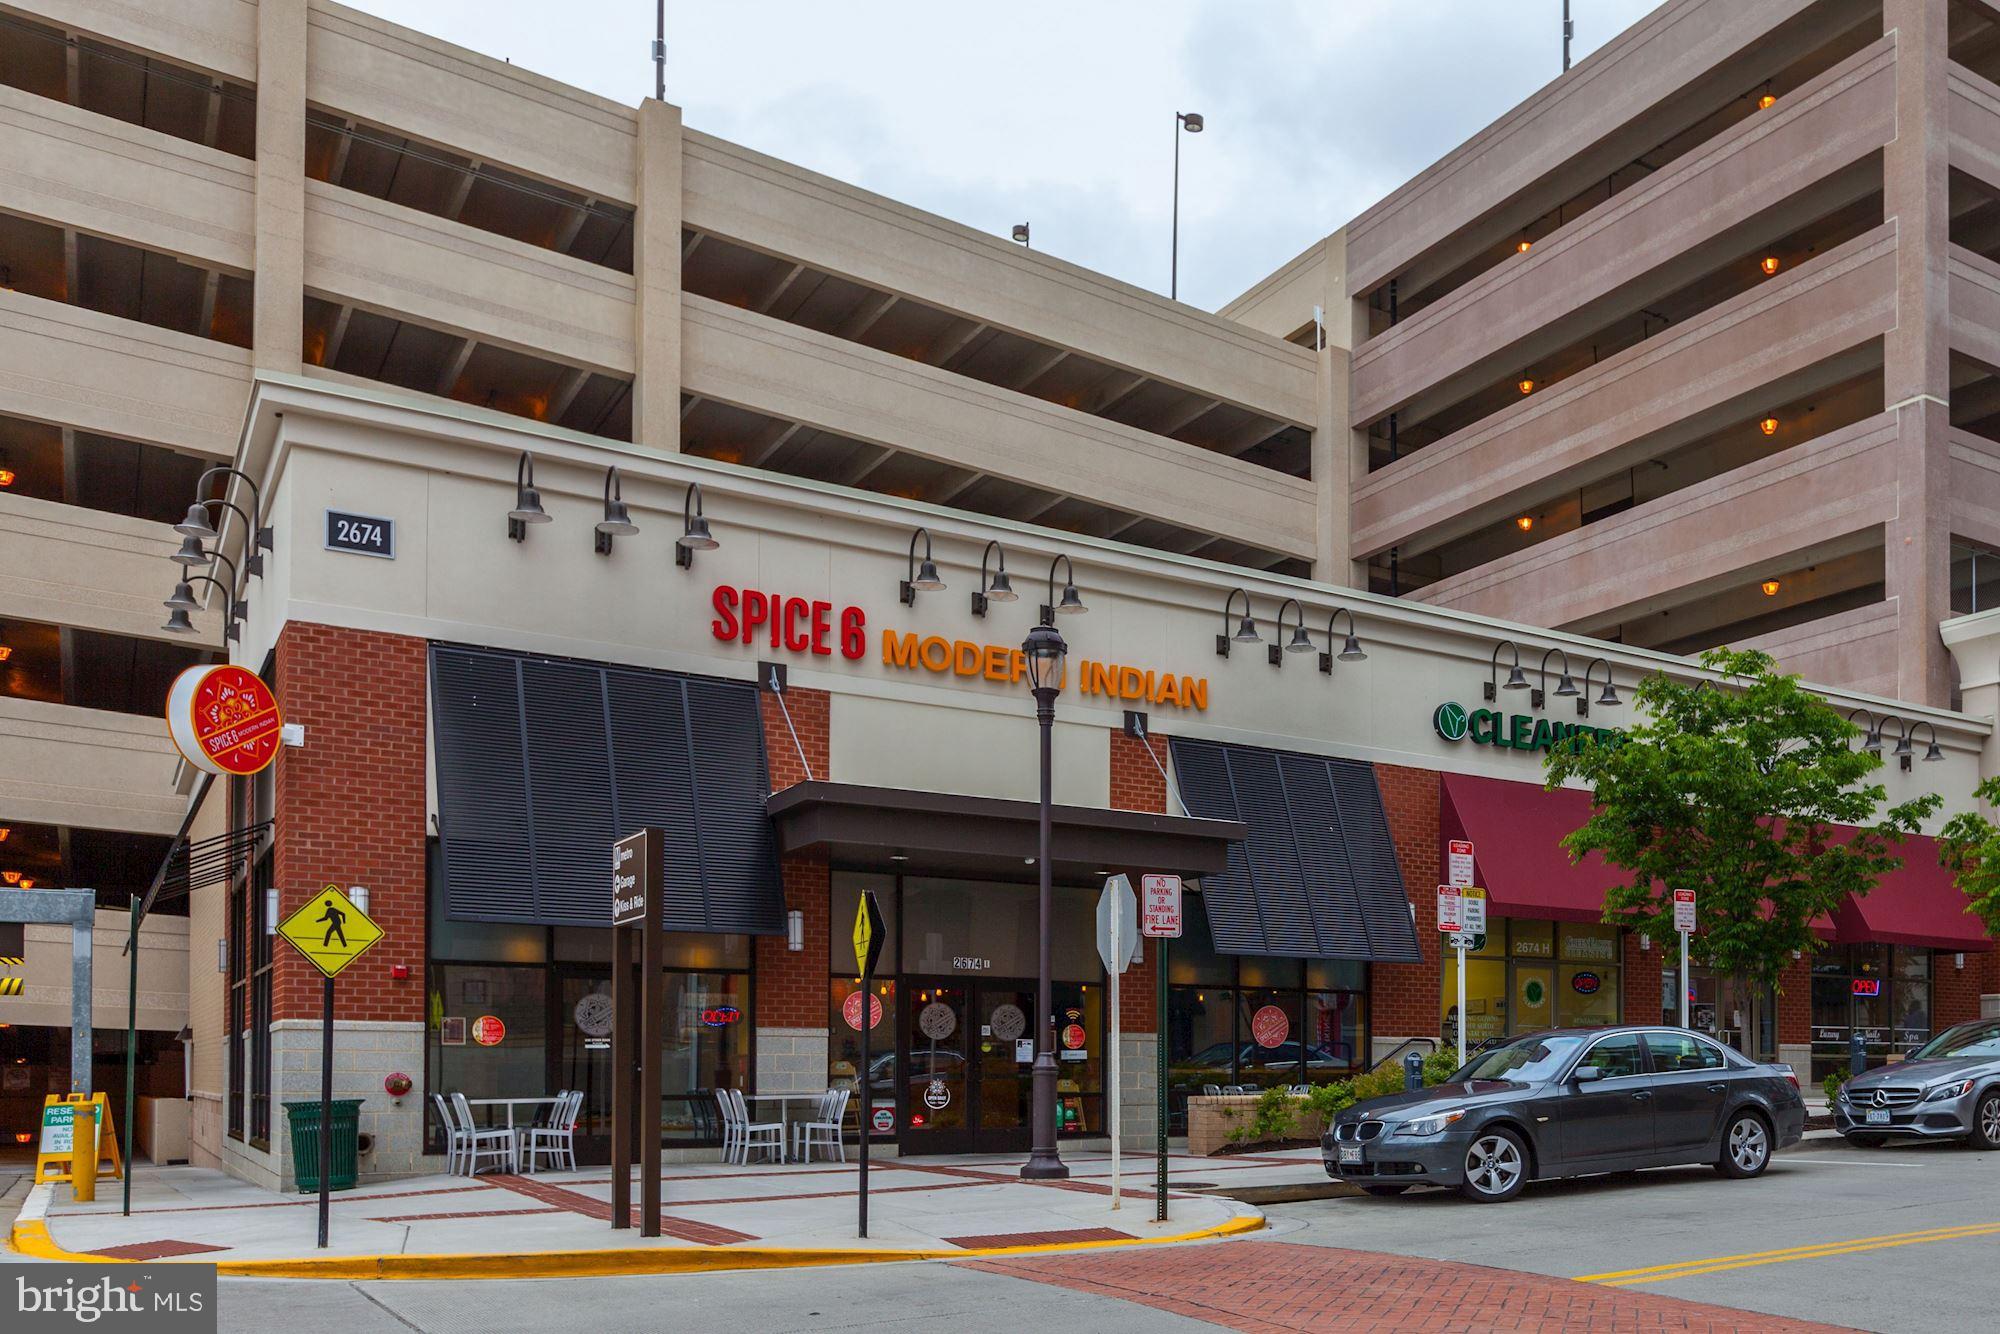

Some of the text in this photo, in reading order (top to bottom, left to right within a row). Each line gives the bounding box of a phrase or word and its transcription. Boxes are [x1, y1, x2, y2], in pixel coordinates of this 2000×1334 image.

[337, 520, 382, 547] 2674
[711, 585, 1208, 709] SPICE 6 MODER INDIAN
[208, 717, 276, 752] SPICE 6 MODERN INDIAN
[620, 848, 634, 861] metro
[620, 875, 636, 889] Garage
[1150, 888, 1173, 896] PARKING
[1467, 890, 1481, 898] NOTICE
[620, 894, 644, 913] Kiss & Ride
[1157, 896, 1166, 904] OR
[1149, 905, 1175, 913] STANDING
[1145, 915, 1179, 925] FIRE LANE
[1516, 942, 1550, 954] 2674 H
[954, 957, 981, 969] 2674
[1853, 980, 1877, 993] OPEN
[701, 1009, 741, 1023] OPEN
[1820, 1029, 1840, 1040] Luxury
[1904, 1031, 1919, 1042] Spa
[46, 1106, 99, 1115] RESED
